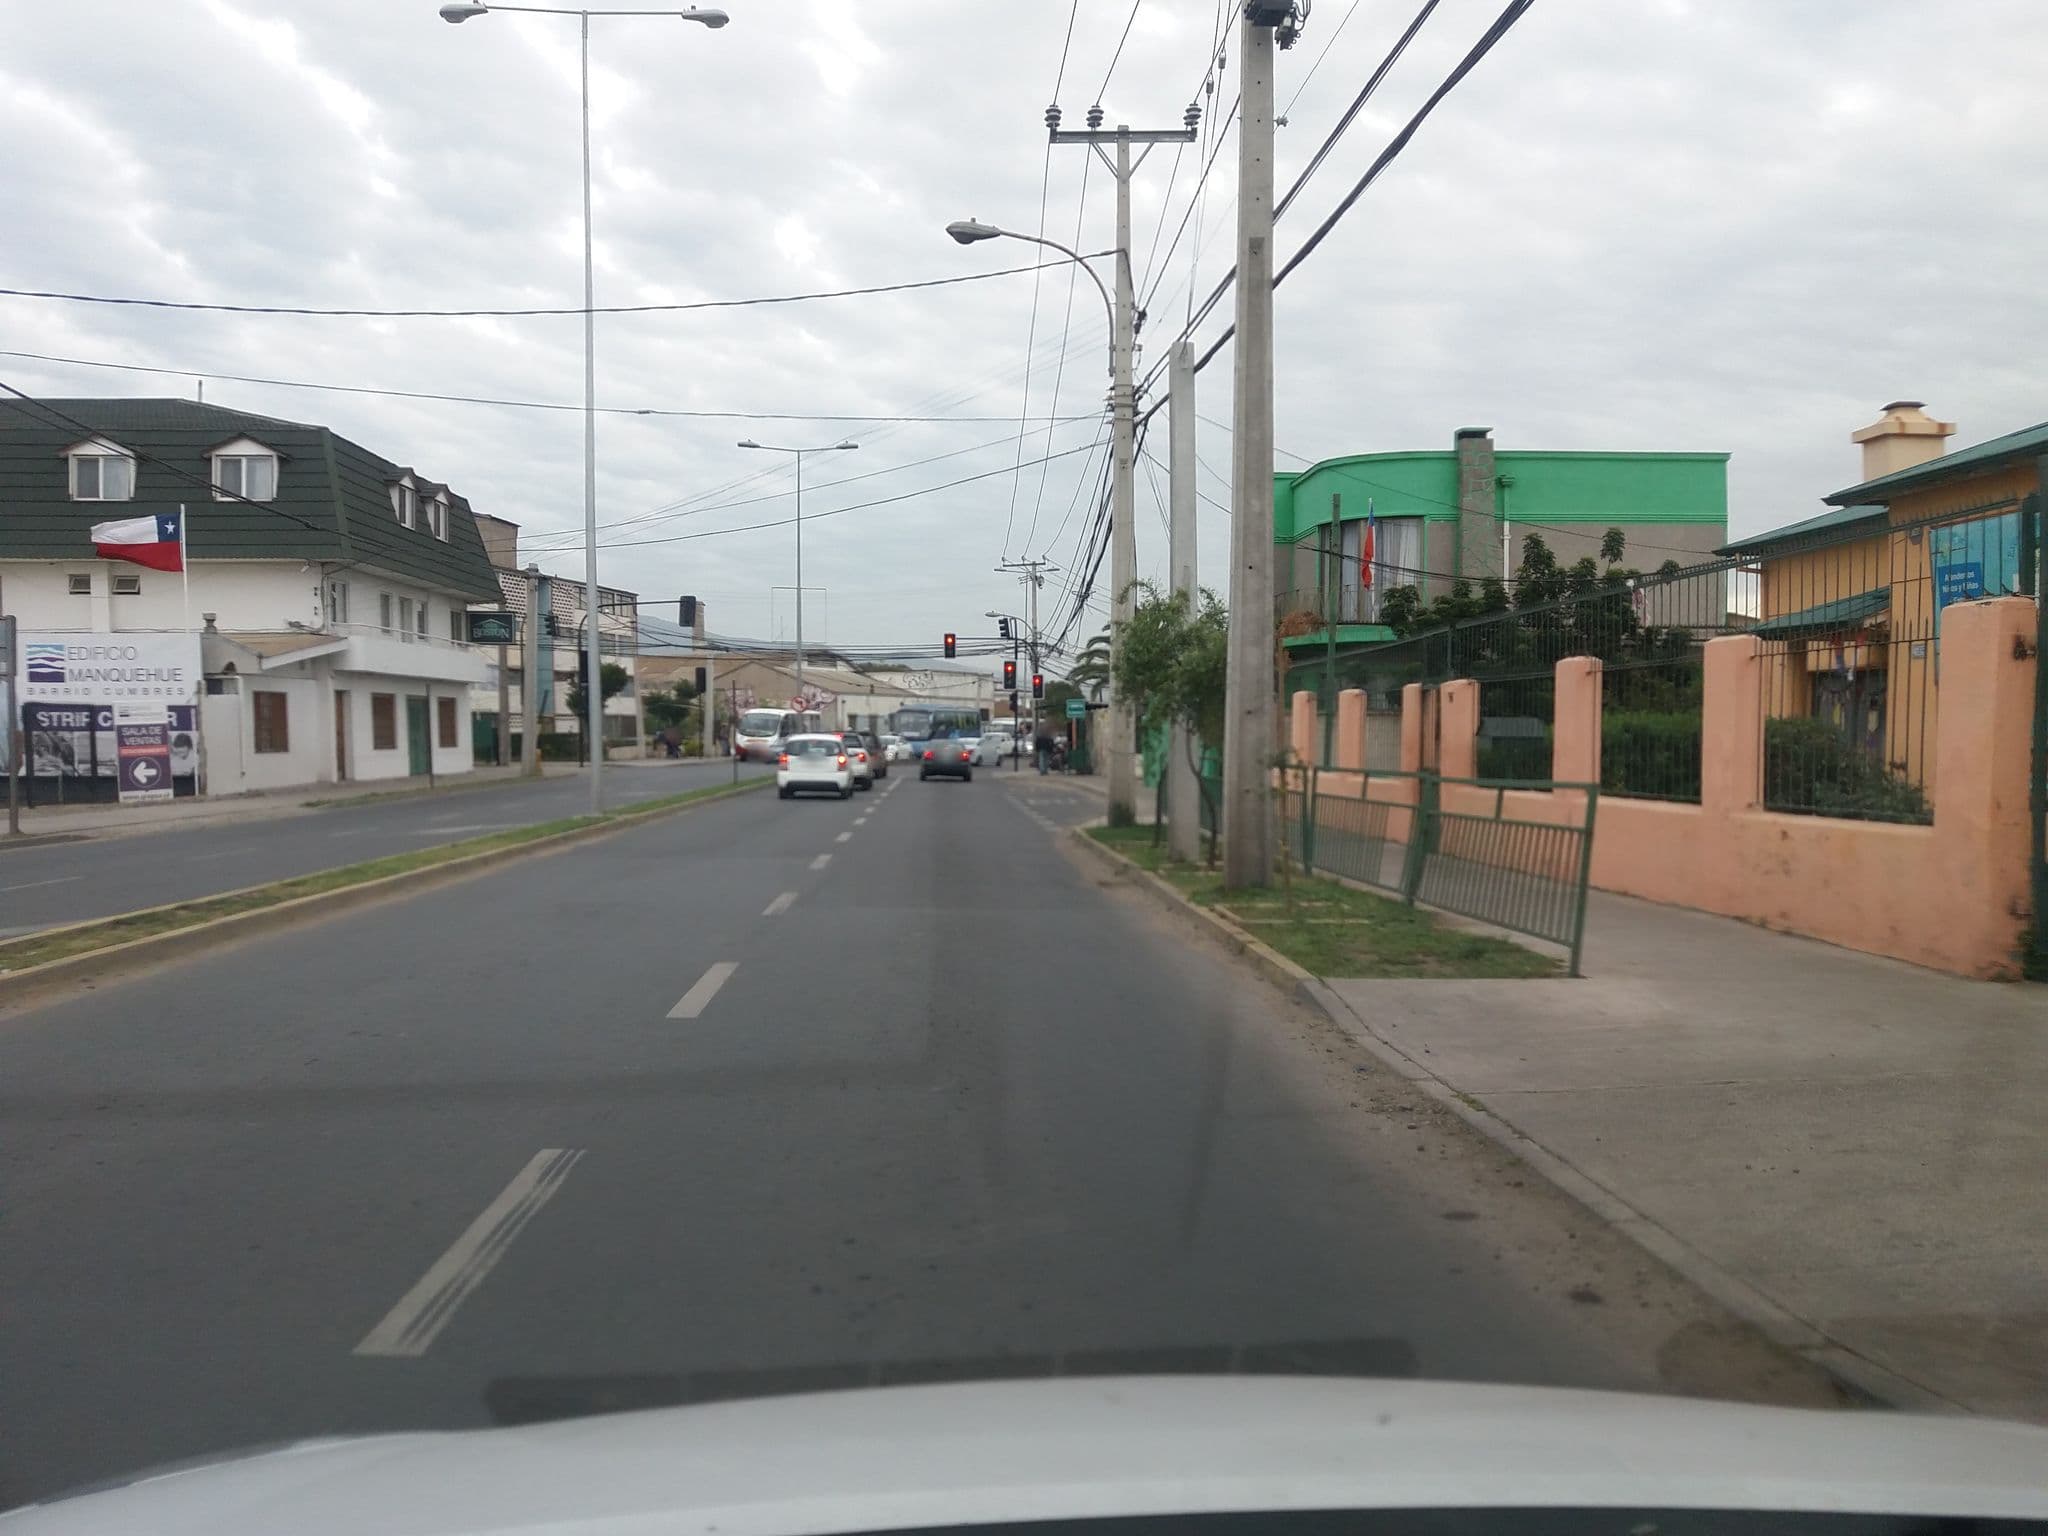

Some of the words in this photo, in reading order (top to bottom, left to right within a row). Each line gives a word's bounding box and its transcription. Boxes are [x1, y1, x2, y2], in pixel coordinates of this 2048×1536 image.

[67, 646, 137, 661] EDIFICIO
[68, 667, 184, 682] MANQUEHUE
[26, 686, 91, 696] BARRIO
[103, 686, 185, 696] CUMBRES
[121, 727, 147, 736] SALA
[148, 726, 162, 735] DE
[123, 736, 162, 745] VENTAS
